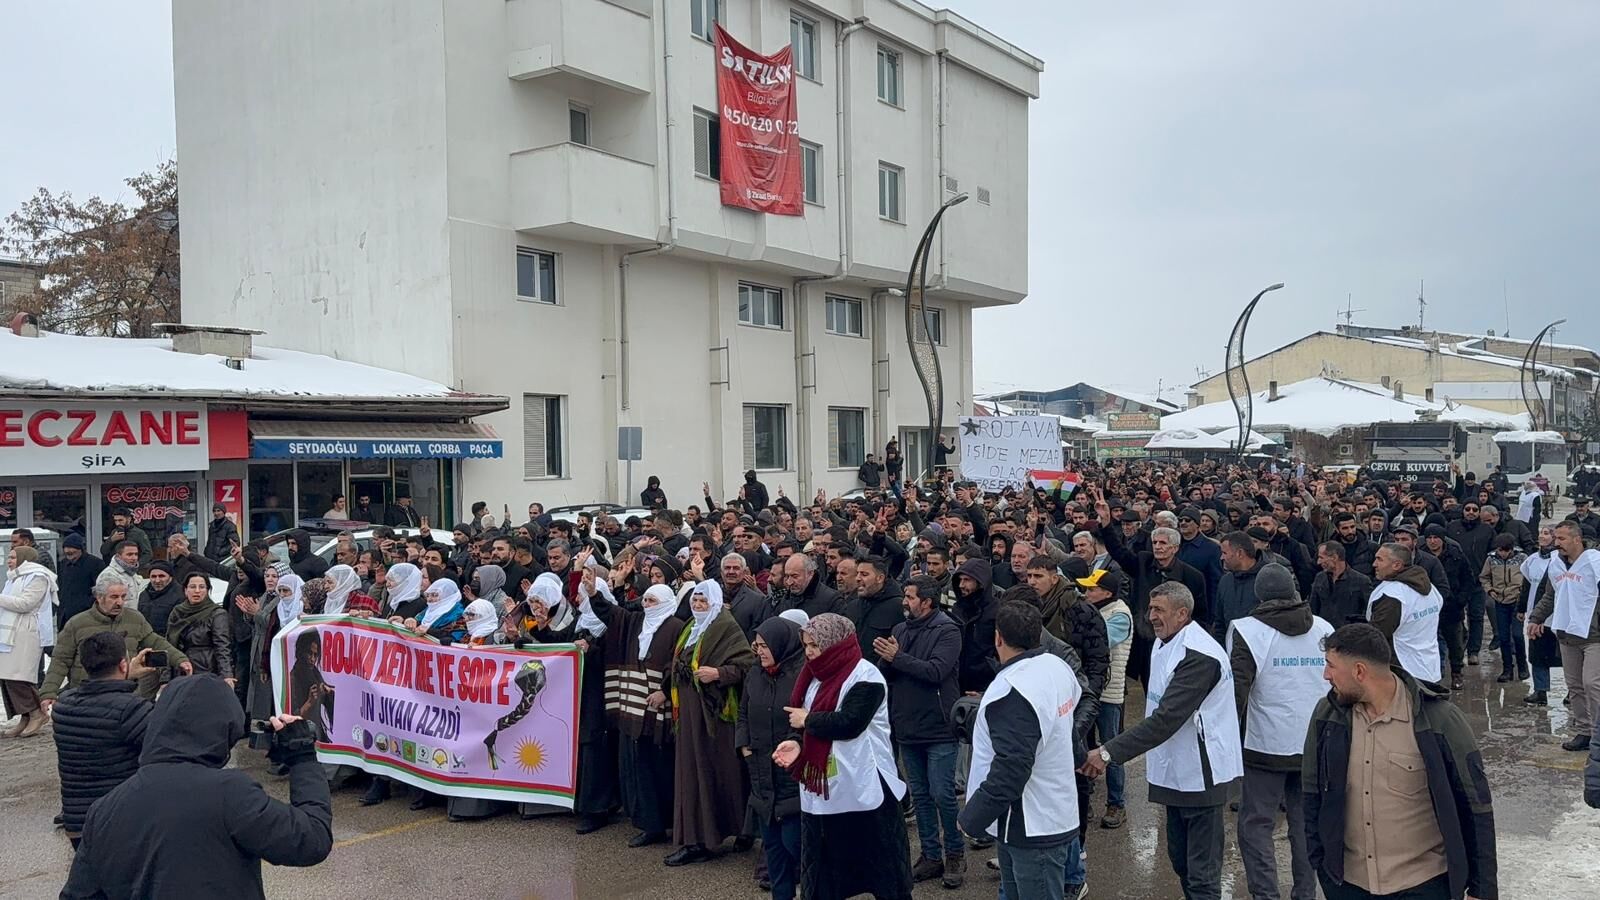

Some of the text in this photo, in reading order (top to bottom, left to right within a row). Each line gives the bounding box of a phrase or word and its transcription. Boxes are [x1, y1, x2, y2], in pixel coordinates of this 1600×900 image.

[750, 116, 772, 132] 220
[0, 410, 200, 447] ECZANE
[978, 419, 1055, 440] ROJAVA
[289, 441, 493, 456] SEYDAOĞLU LOKANTA ÇORBA PAÇA
[82, 453, 126, 468] ŞİFA
[1406, 463, 1450, 472] KUVVET
[107, 485, 190, 503] eczane
[133, 503, 167, 525] şifa
[1273, 657, 1279, 666] BI
[457, 655, 497, 704] SOR
[379, 696, 418, 732] JIYAN
[416, 705, 461, 741] AZADÎ
